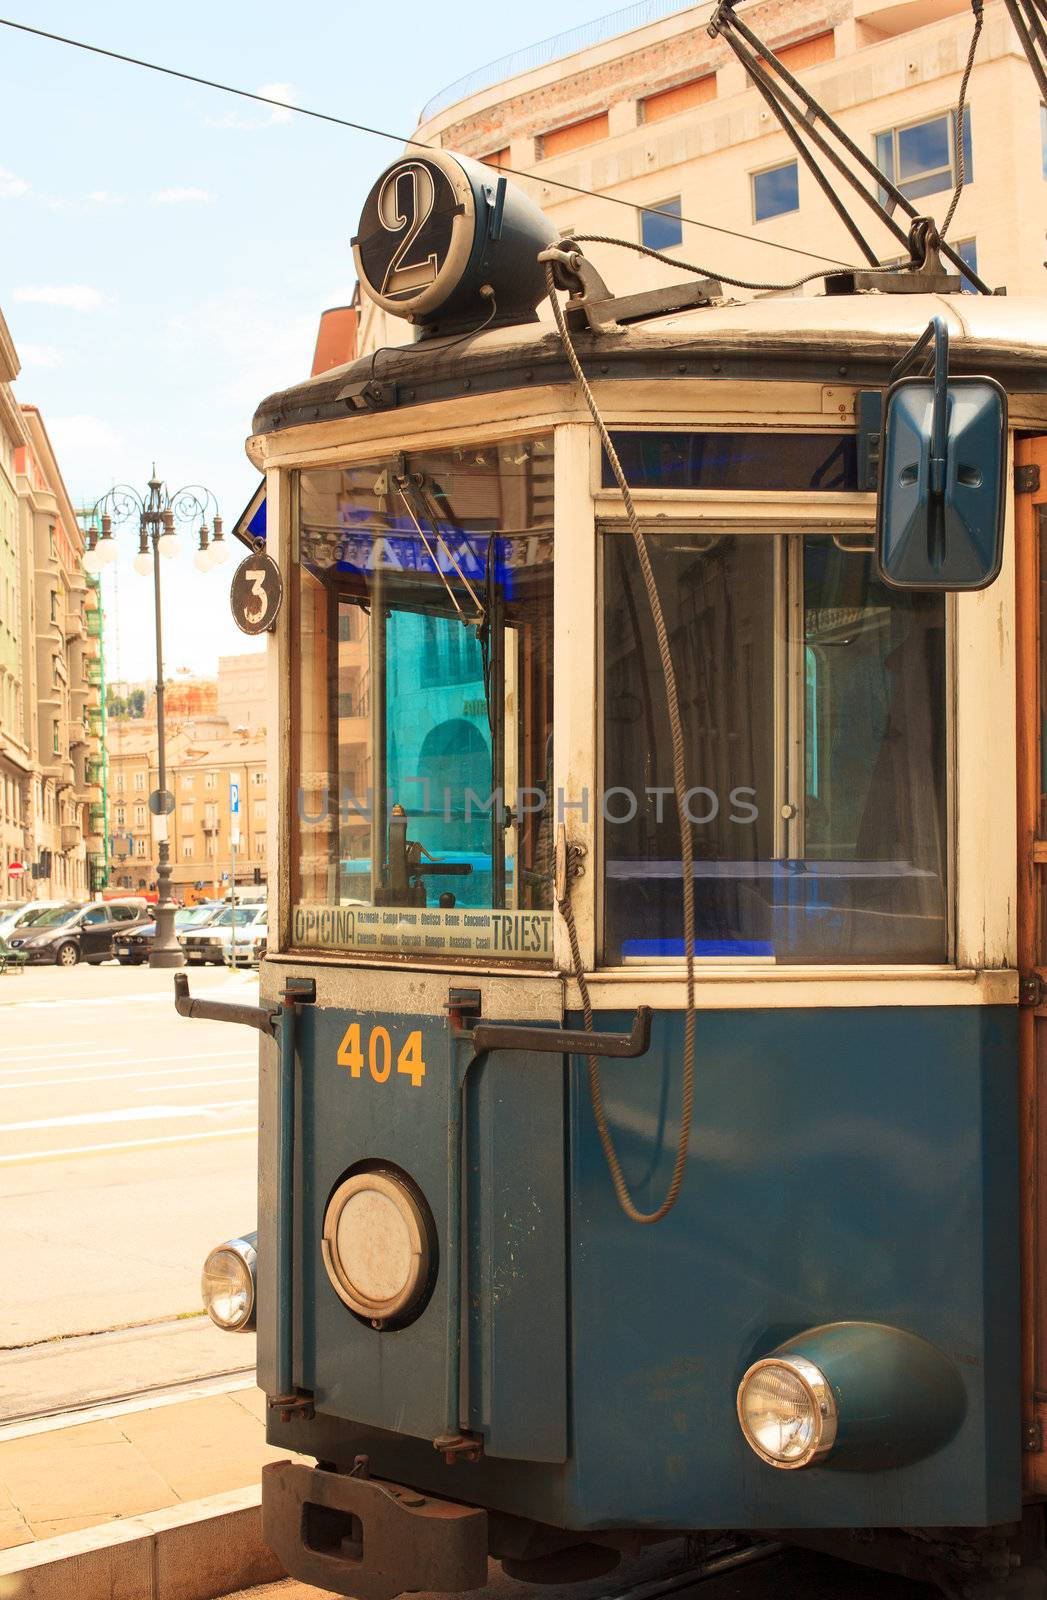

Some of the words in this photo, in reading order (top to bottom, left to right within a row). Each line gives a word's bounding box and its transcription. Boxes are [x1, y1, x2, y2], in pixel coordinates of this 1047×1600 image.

[377, 161, 438, 298] 2
[243, 569, 268, 624] 3
[295, 909, 355, 945] OPICINA
[491, 915, 554, 952] TRIEST
[337, 1023, 426, 1087] 404
